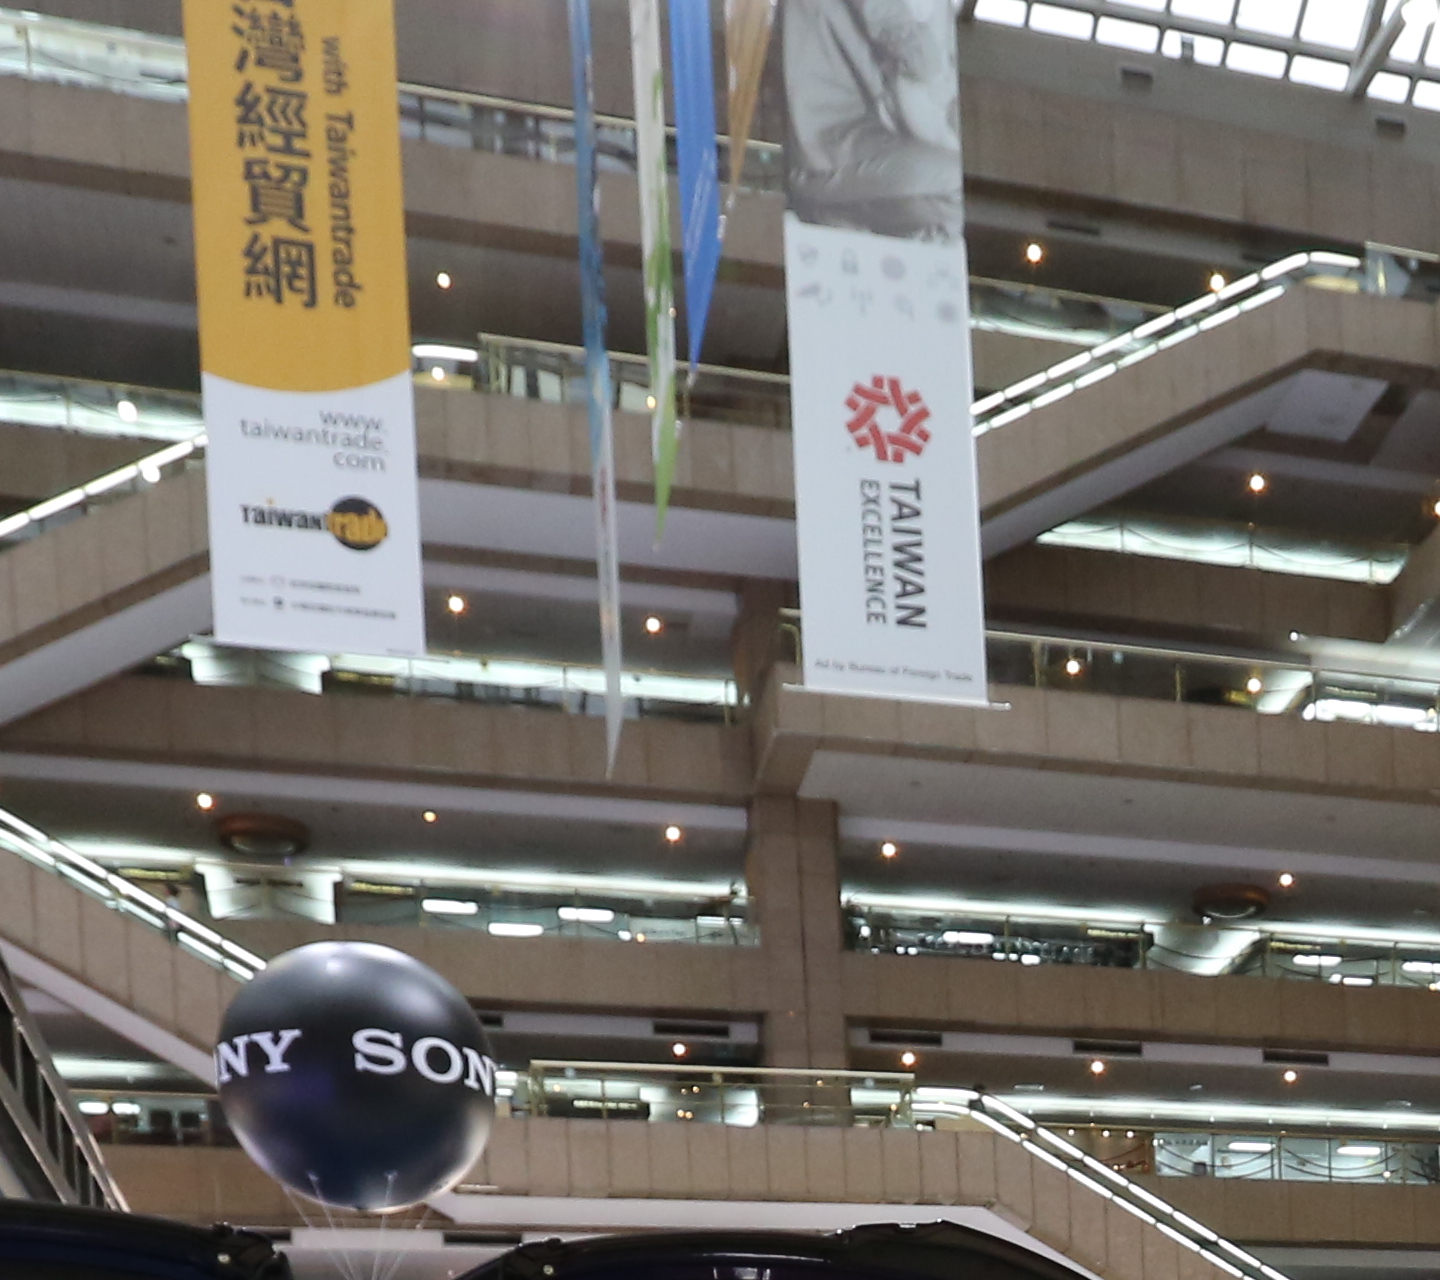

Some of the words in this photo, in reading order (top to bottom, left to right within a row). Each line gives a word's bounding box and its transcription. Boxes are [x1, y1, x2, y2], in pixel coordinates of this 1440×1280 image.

[320, 35, 348, 95] with
[231, 0, 317, 309] 灣經貿網
[324, 110, 364, 309] Taiwantrade
[332, 451, 386, 472] com
[860, 478, 888, 625] EXCELLENCE
[888, 478, 927, 629] TAIWAN
[215, 1028, 302, 1084] NY
[351, 1028, 495, 1097] SON
